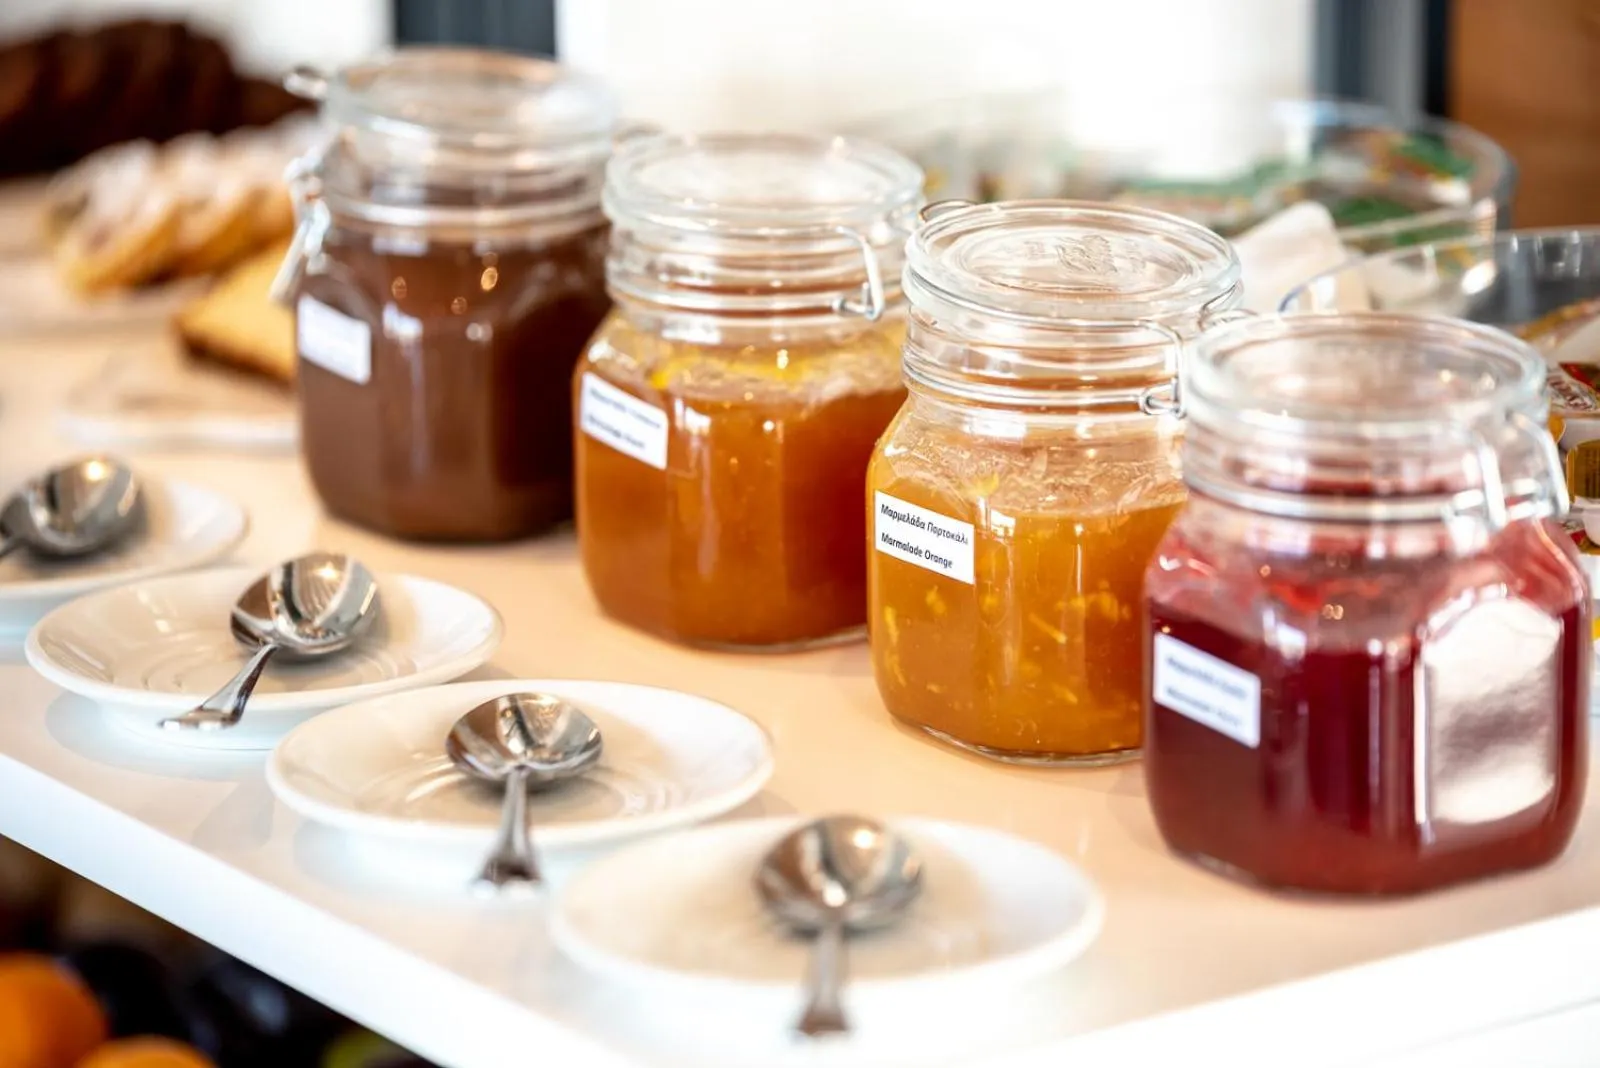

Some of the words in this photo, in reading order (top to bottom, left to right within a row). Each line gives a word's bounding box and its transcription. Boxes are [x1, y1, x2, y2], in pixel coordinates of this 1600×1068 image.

[881, 504, 926, 529] Μαρμελάδα
[881, 532, 923, 557] Marmalade
[924, 549, 953, 569] Orange
